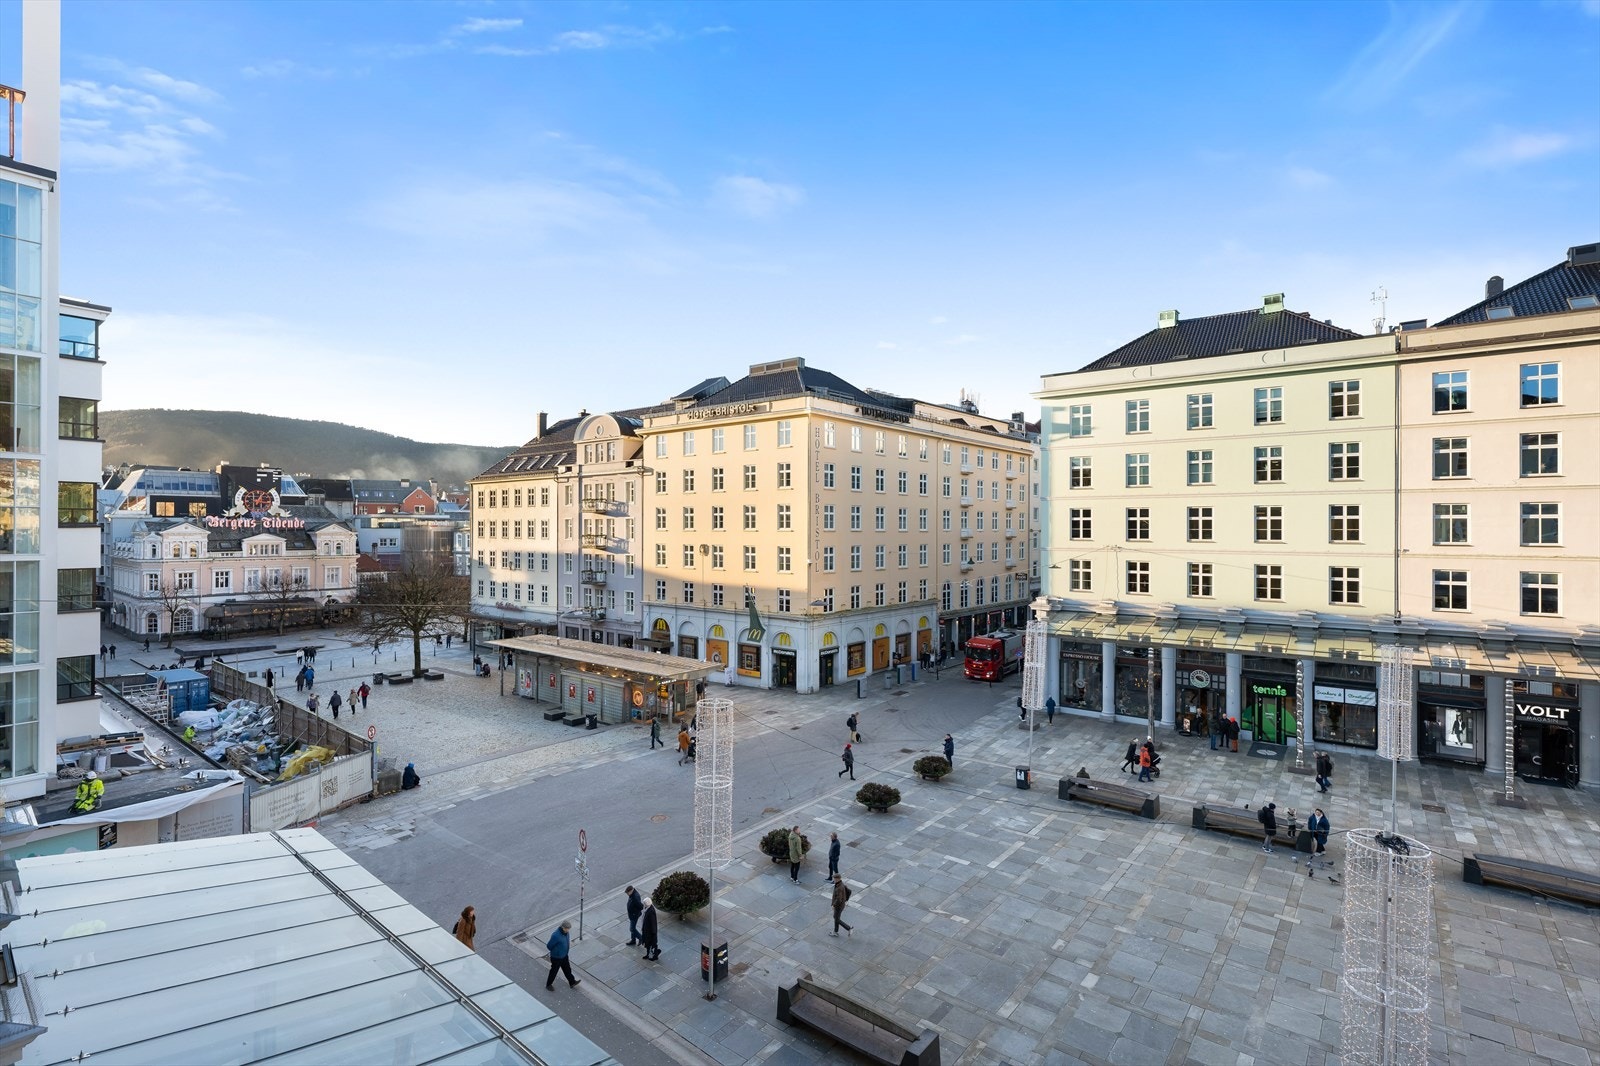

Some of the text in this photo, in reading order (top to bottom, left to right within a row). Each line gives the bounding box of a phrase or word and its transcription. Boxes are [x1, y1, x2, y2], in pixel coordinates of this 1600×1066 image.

[715, 403, 751, 416] BRISTOL
[206, 515, 305, 530] Bergens Tidende
[1252, 685, 1287, 696] tennis
[1516, 704, 1569, 719] VOLT
[1526, 716, 1559, 724] MAGASIN
